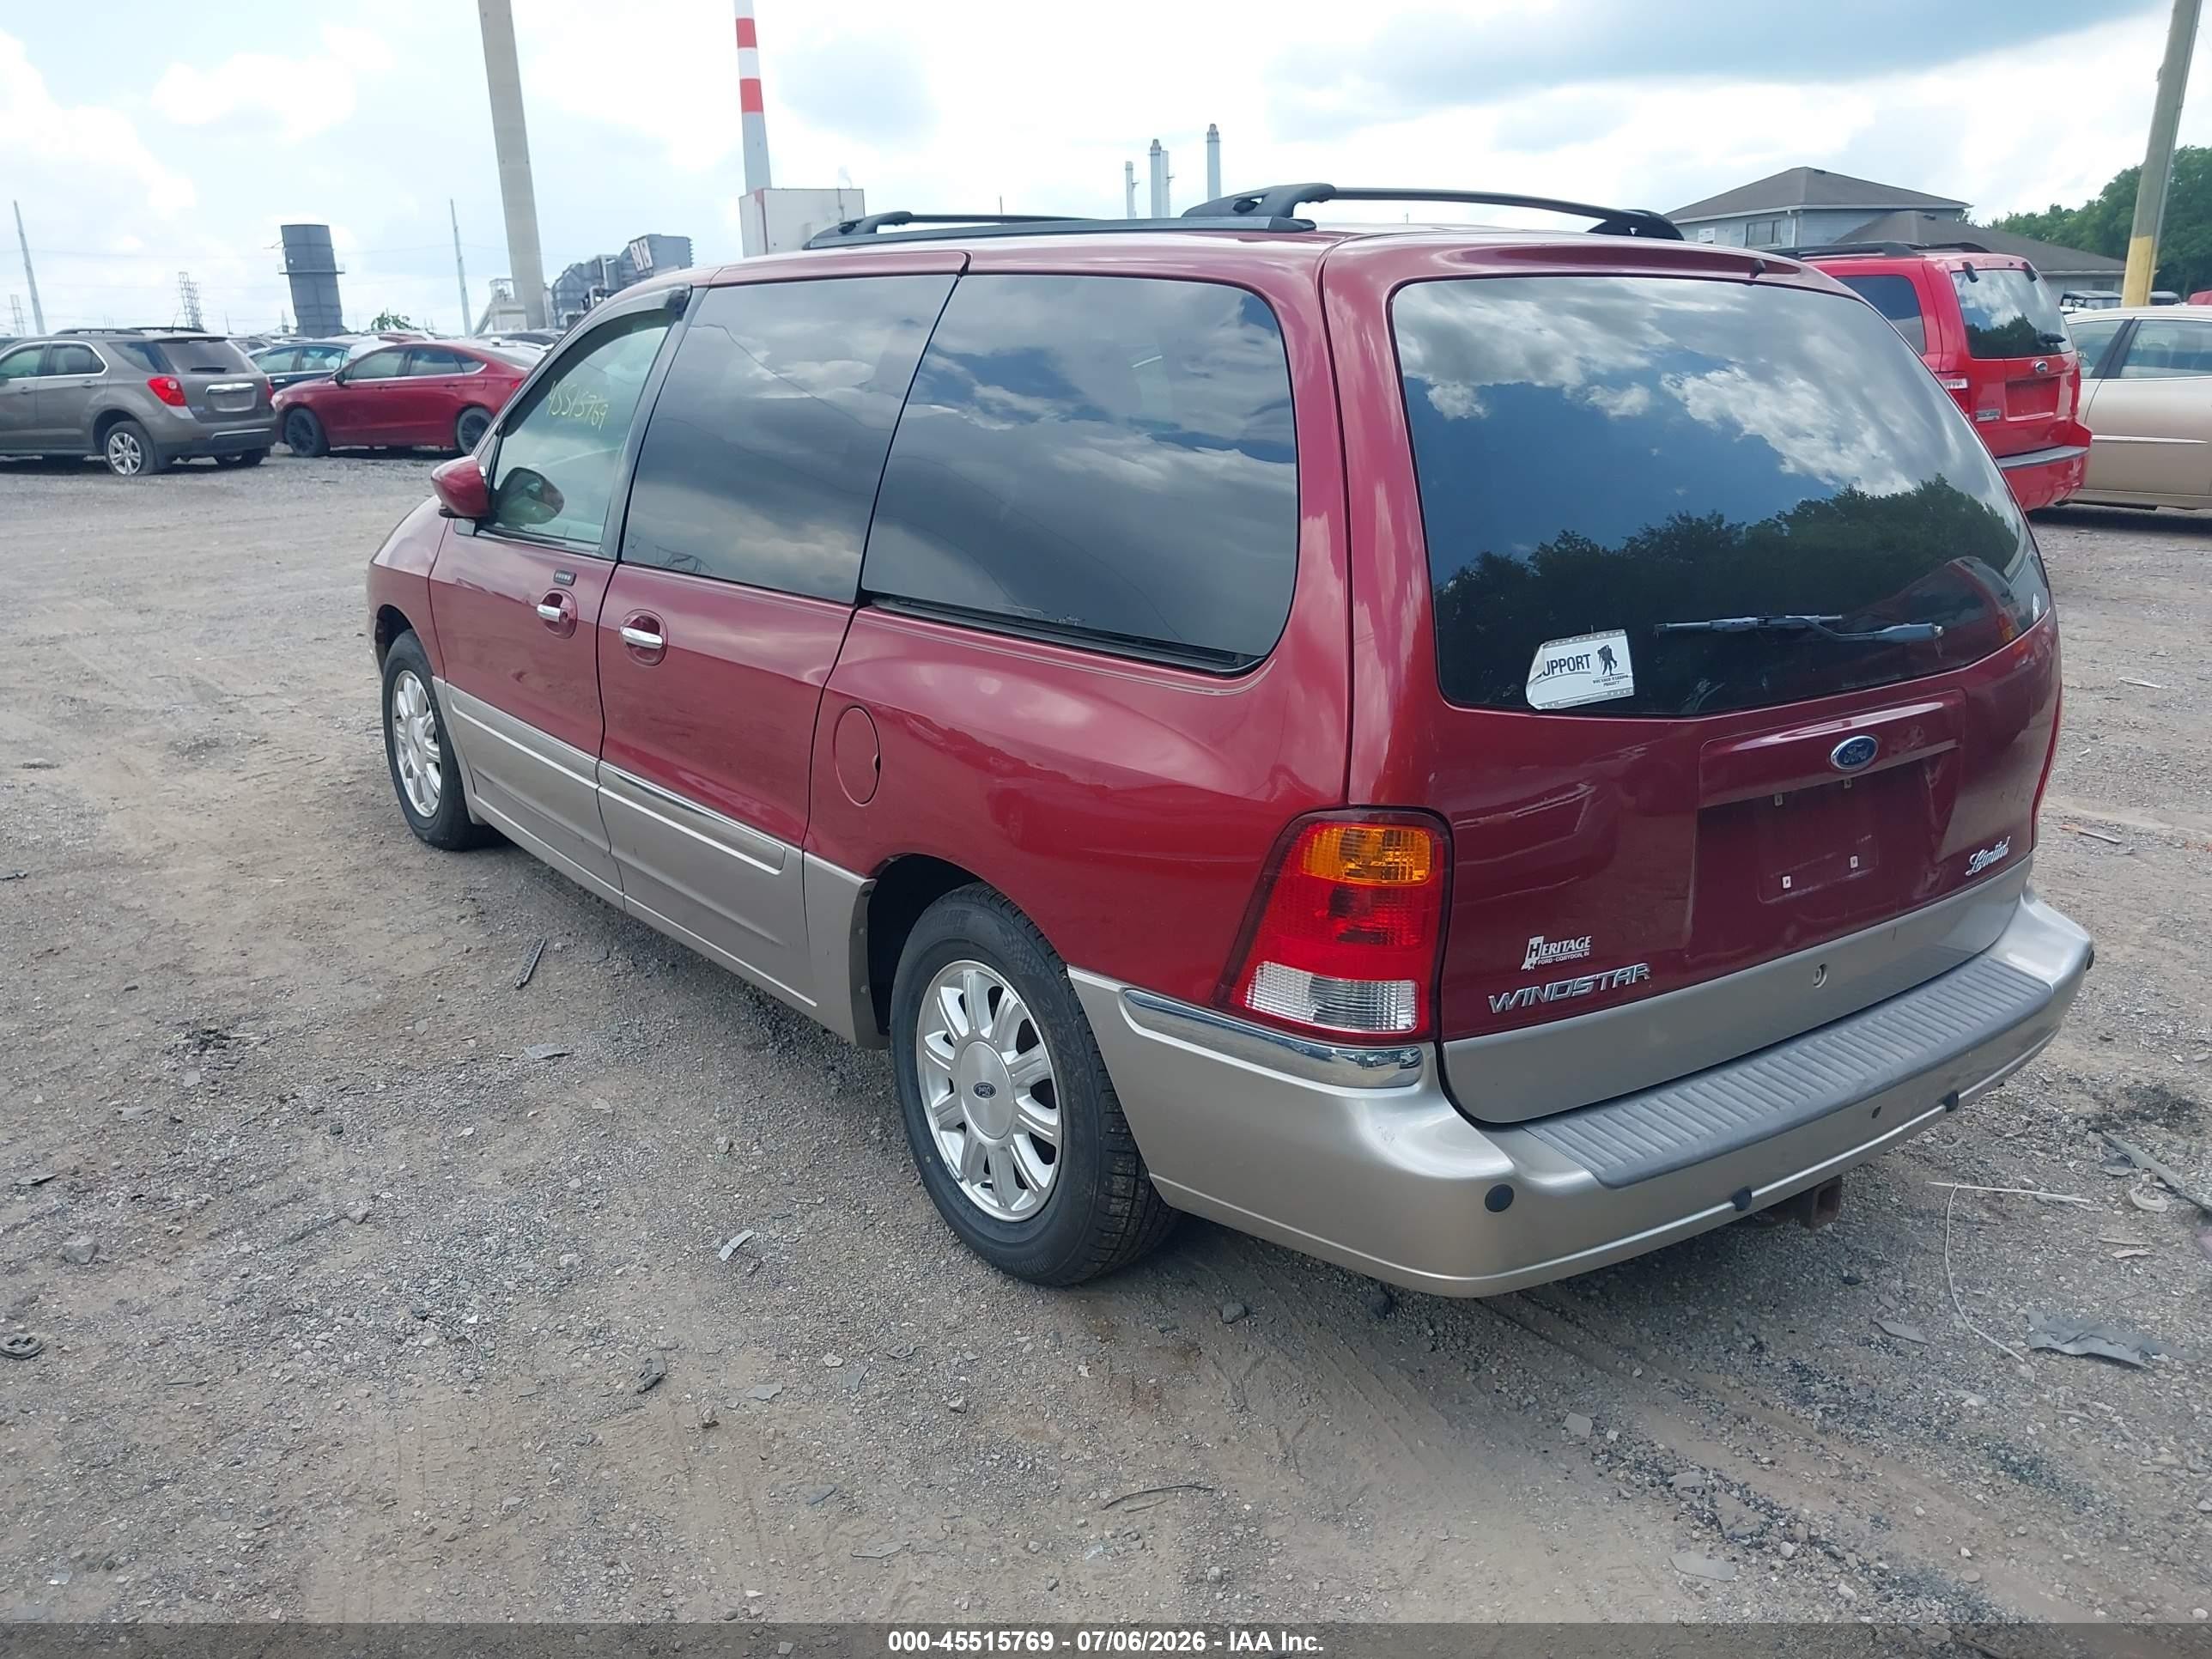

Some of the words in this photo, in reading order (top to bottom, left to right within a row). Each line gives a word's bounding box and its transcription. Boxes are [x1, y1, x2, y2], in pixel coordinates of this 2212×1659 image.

[1536, 653, 1591, 678] UPPORT
[1966, 836, 2011, 876] Limited
[1528, 935, 1592, 959] HERITAGE
[1488, 963, 1650, 1013] WINDSTAR
